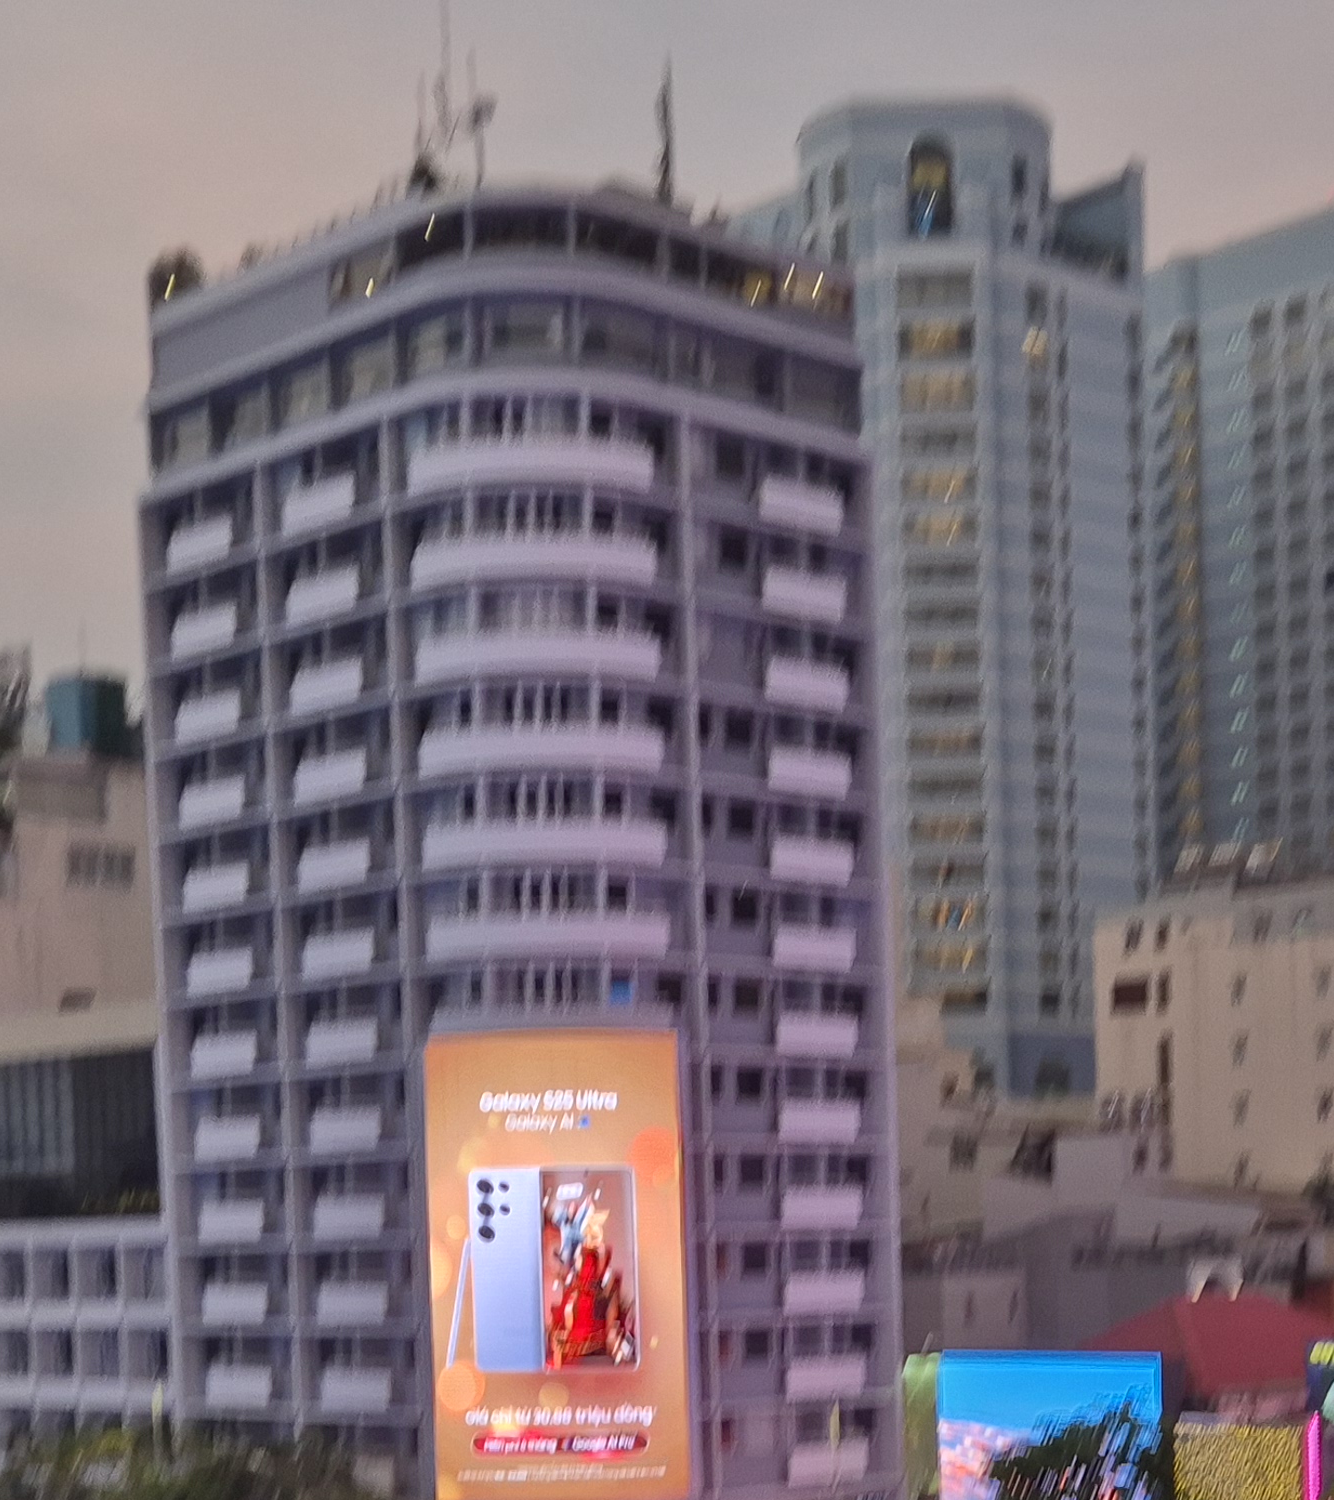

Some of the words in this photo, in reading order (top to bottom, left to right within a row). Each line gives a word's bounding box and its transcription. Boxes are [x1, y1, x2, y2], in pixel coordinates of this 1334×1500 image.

[479, 1090, 542, 1115] Galaxy
[575, 1088, 618, 1112] Ultra
[505, 1112, 559, 1135] Galaxy
[559, 1111, 575, 1131] AI
